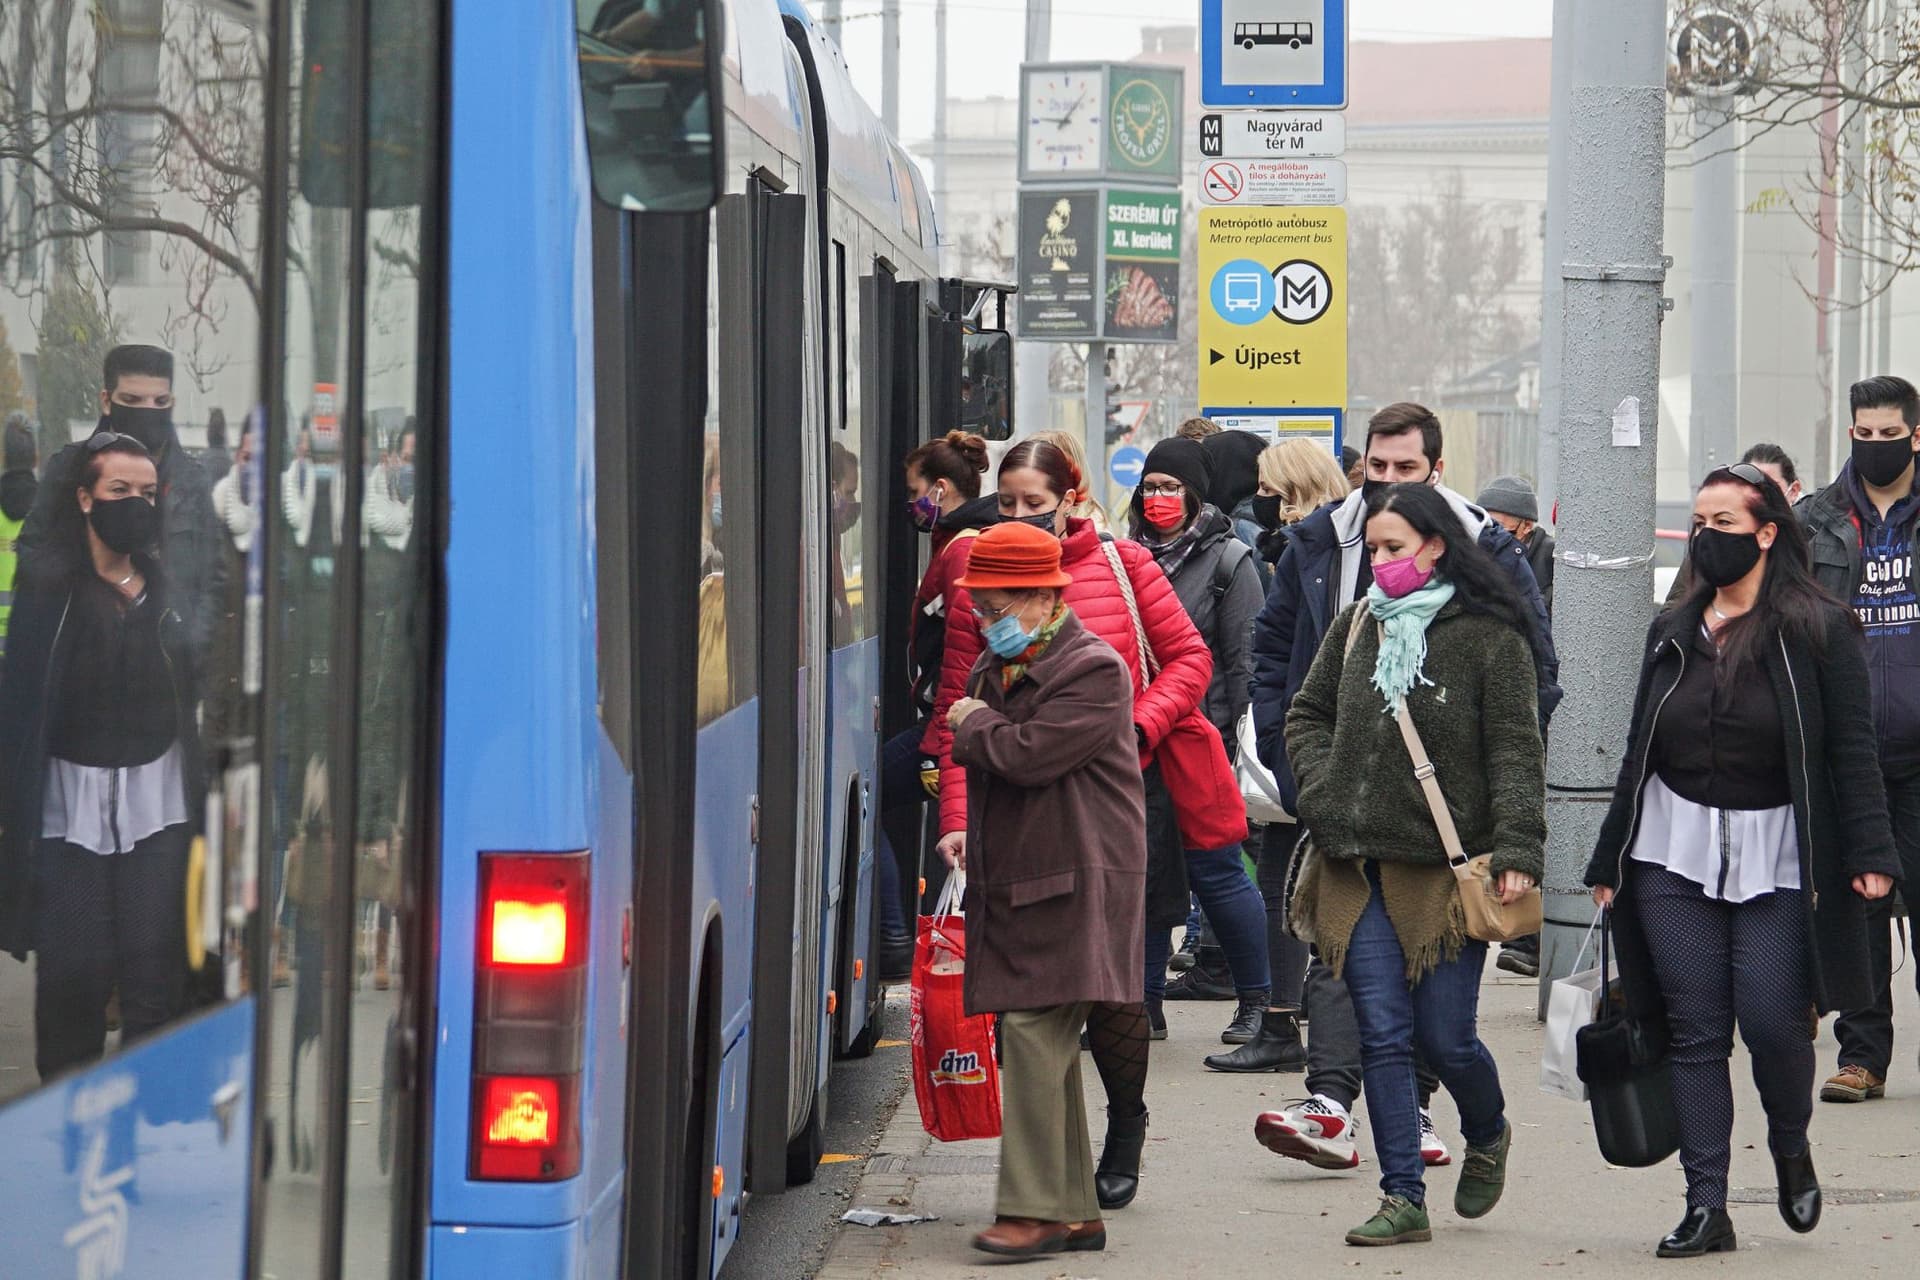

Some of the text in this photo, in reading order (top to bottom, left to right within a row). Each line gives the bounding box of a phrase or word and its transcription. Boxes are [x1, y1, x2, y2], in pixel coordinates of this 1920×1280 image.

[1204, 120, 1219, 134] M
[1247, 118, 1322, 136] Nagyvárad
[1204, 137, 1219, 151] M
[1266, 135, 1304, 149] tér M
[1108, 203, 1179, 226] SZERÉMI ÚT
[1209, 217, 1328, 231] Metrópótló autóbusz
[1131, 230, 1173, 250] kerület
[1209, 234, 1333, 245] Metro replacement bus
[1235, 344, 1301, 369] Újpest
[941, 1050, 976, 1073] dm
